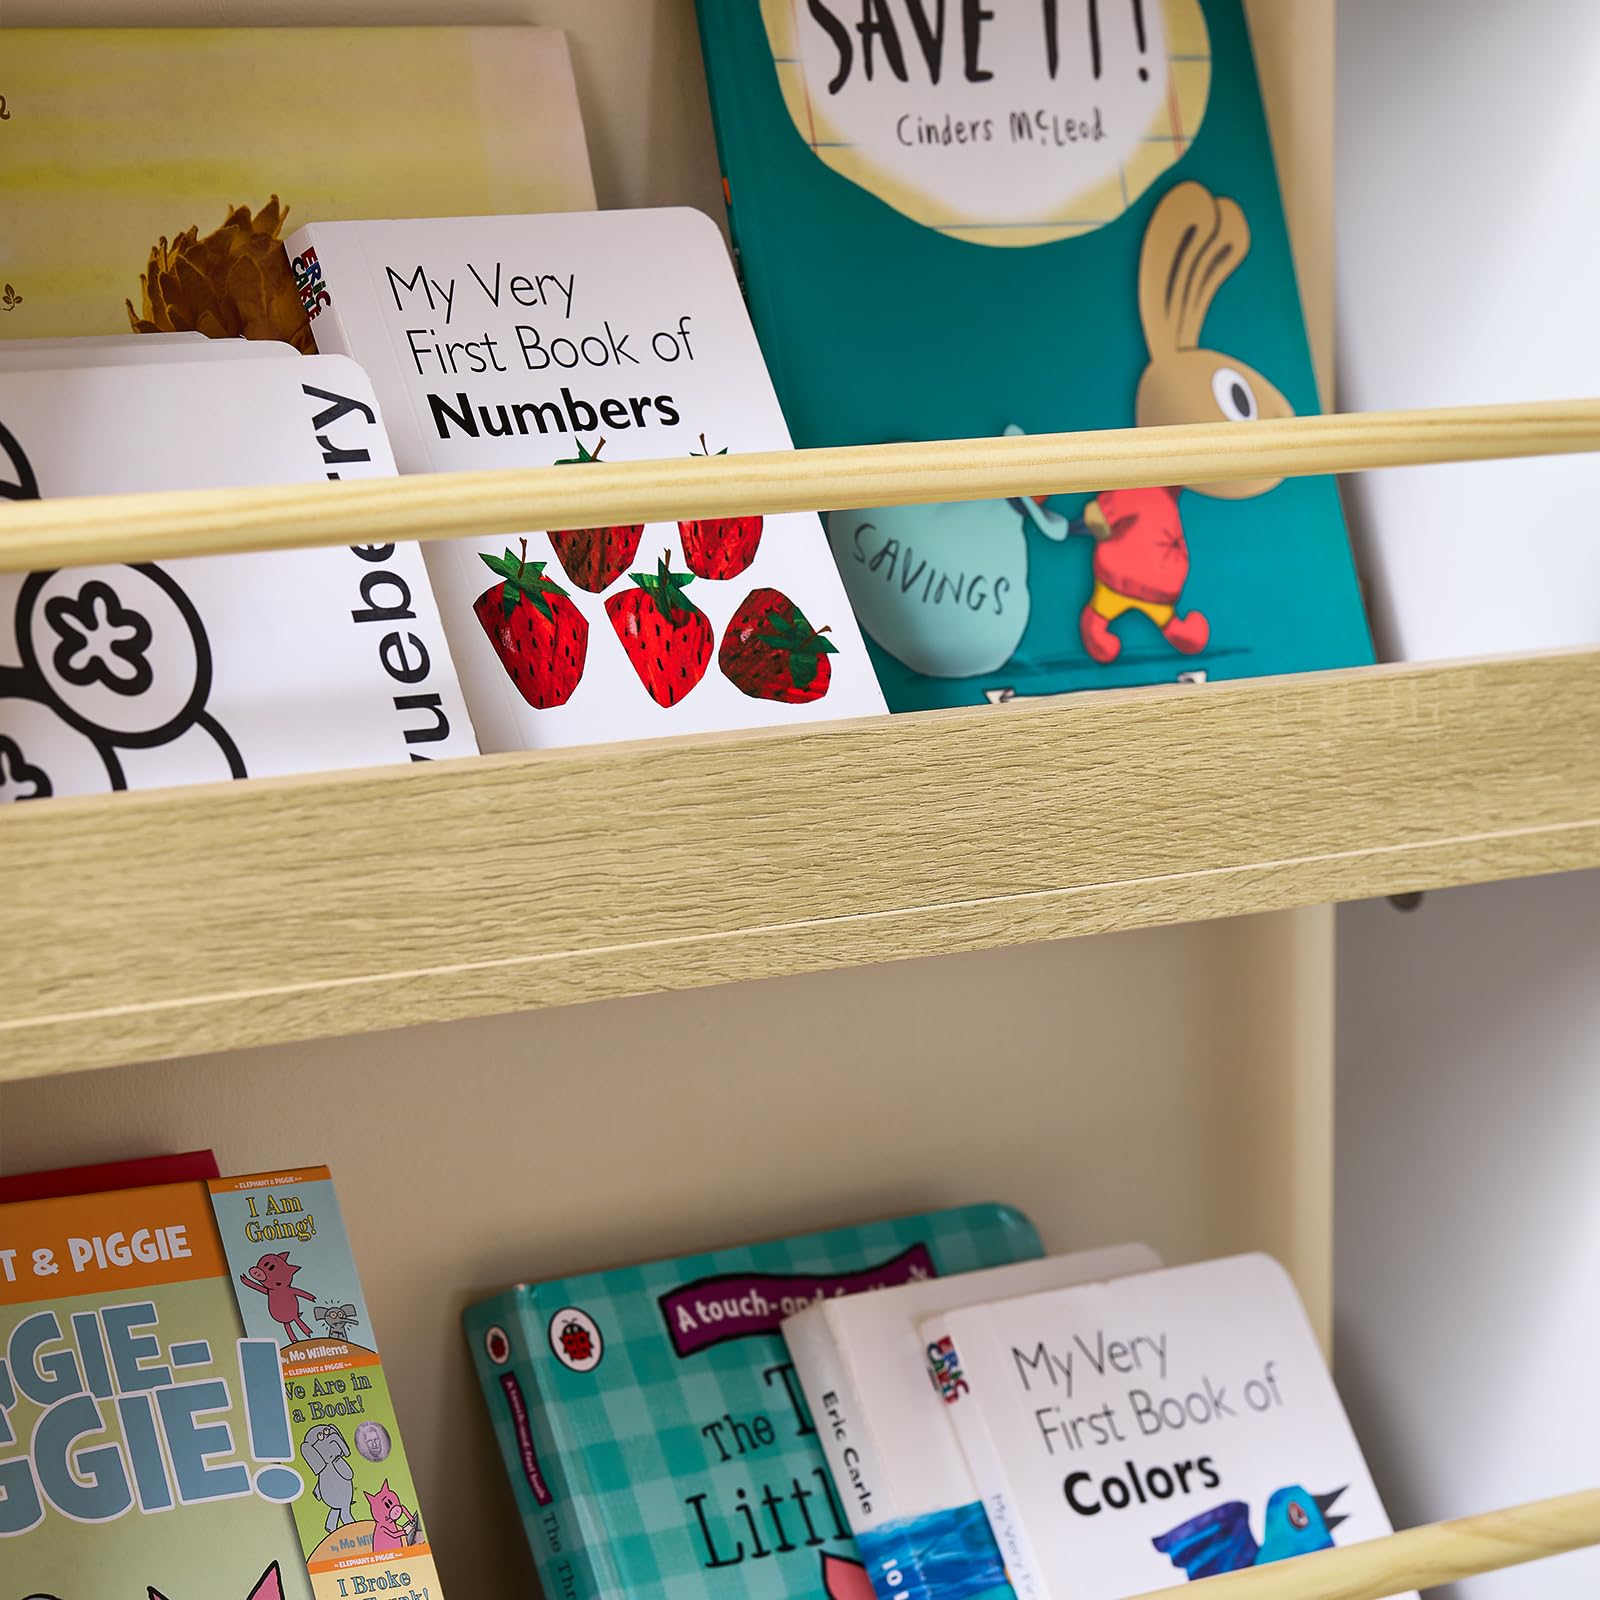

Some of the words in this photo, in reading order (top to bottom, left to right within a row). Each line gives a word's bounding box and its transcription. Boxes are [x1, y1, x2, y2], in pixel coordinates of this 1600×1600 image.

[897, 114, 994, 147] Cinders
[1009, 106, 1106, 147] McLeod
[385, 265, 455, 324] My
[467, 262, 574, 319] Very
[405, 329, 507, 375] First
[514, 321, 640, 370] Book
[652, 316, 694, 362] of
[426, 387, 680, 439] Numbers
[853, 522, 1011, 615] SAVINGS
[245, 1196, 259, 1217] I
[266, 1194, 304, 1215] Am
[245, 1214, 317, 1243] Going!
[32, 1248, 60, 1277] &
[67, 1225, 192, 1273] PIGGIE
[676, 1304, 698, 1333] A
[0, 1301, 213, 1415] GIE-
[289, 1350, 306, 1362] Mo
[306, 1344, 349, 1360] Willems
[1011, 1341, 1074, 1399] My
[1073, 1329, 1167, 1380] Very
[292, 1408, 306, 1424] a
[308, 1394, 366, 1421] Book!
[312, 1377, 347, 1398] Are
[350, 1372, 373, 1392] in
[1034, 1403, 1127, 1455] First
[1127, 1375, 1238, 1436] Book
[1244, 1360, 1284, 1413] of
[702, 1414, 776, 1462] The
[822, 1389, 847, 1442] Eric
[843, 1447, 873, 1514] Carle
[1063, 1455, 1221, 1516] Colors
[685, 1466, 854, 1569] Littl
[339, 1538, 356, 1550] Mo
[337, 1578, 349, 1598] I
[350, 1570, 412, 1595] Broke
